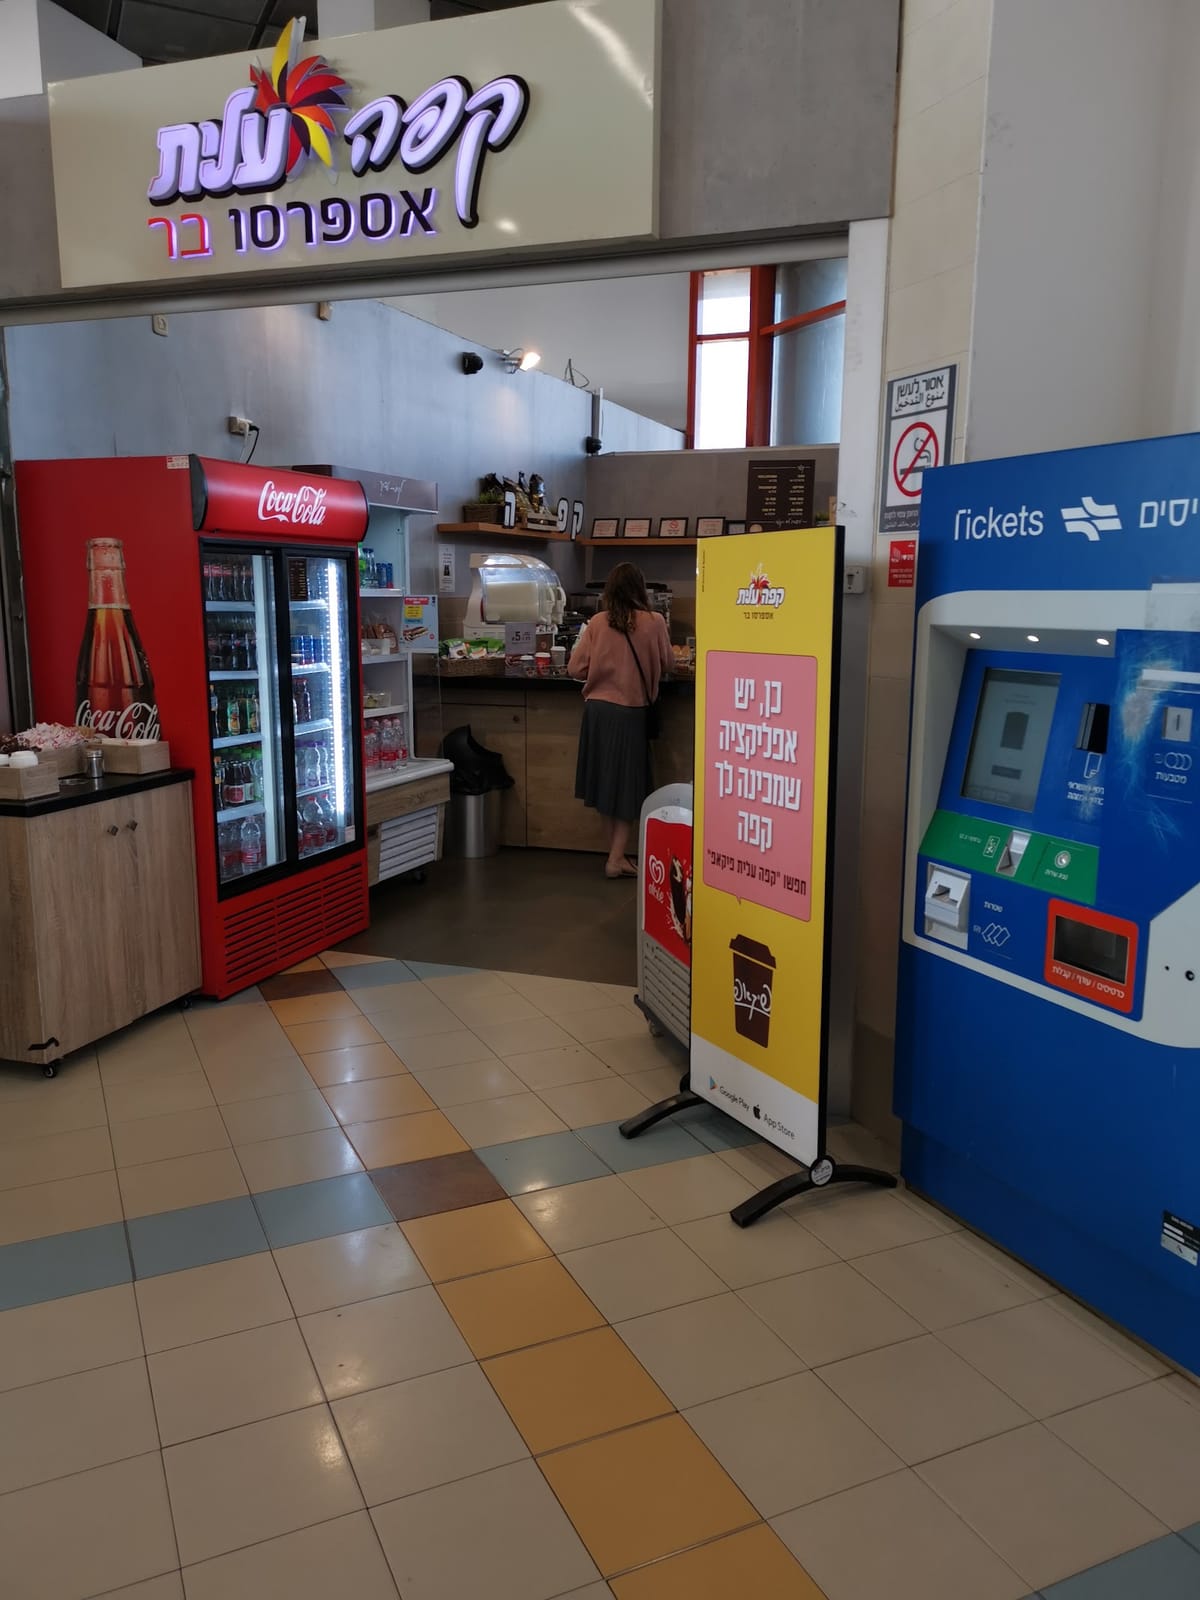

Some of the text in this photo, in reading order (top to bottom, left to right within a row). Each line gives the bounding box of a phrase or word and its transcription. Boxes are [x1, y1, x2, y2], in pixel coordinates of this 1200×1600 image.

[147, 75, 529, 227] קפה עלית
[147, 187, 437, 260] אספרסו בר
[895, 391, 945, 412] ممنوع التدخين
[897, 375, 944, 403] אסור לעשן
[257, 480, 328, 526] Coca-Cola
[954, 504, 1044, 541] Tickets
[736, 583, 785, 608] קפה עלית
[734, 677, 782, 717] כן, יש
[719, 719, 798, 764] אפליקציה
[714, 760, 802, 812] שמכינה לך
[737, 811, 773, 853] קפה
[707, 849, 807, 896] חפשו "קפה עלית פיקאפ"
[1096, 982, 1125, 999] כרטיסים
[719, 1085, 738, 1104] Google
[763, 1113, 778, 1128] App
[778, 1122, 796, 1140] Store
